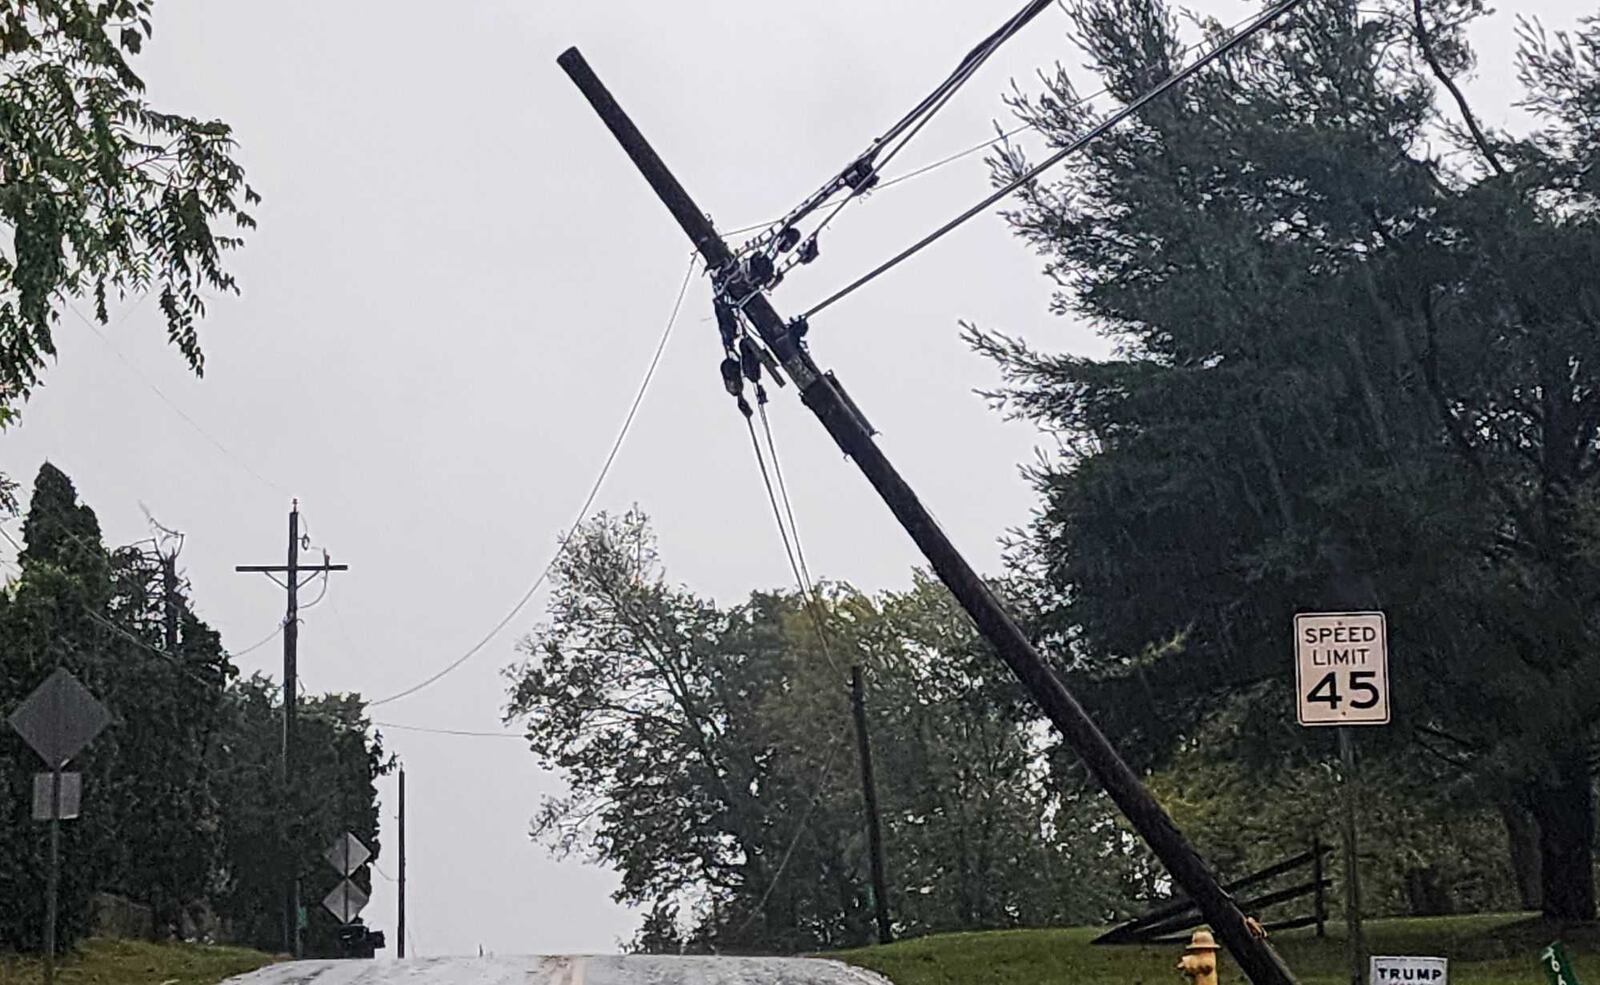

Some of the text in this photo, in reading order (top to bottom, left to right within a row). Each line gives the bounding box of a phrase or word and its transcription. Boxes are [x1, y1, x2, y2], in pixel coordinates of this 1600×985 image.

[1305, 626, 1376, 643] SPEED
[1312, 648, 1370, 666] LIMIT
[1306, 671, 1380, 710] 45
[1377, 968, 1442, 980] TRUMP
